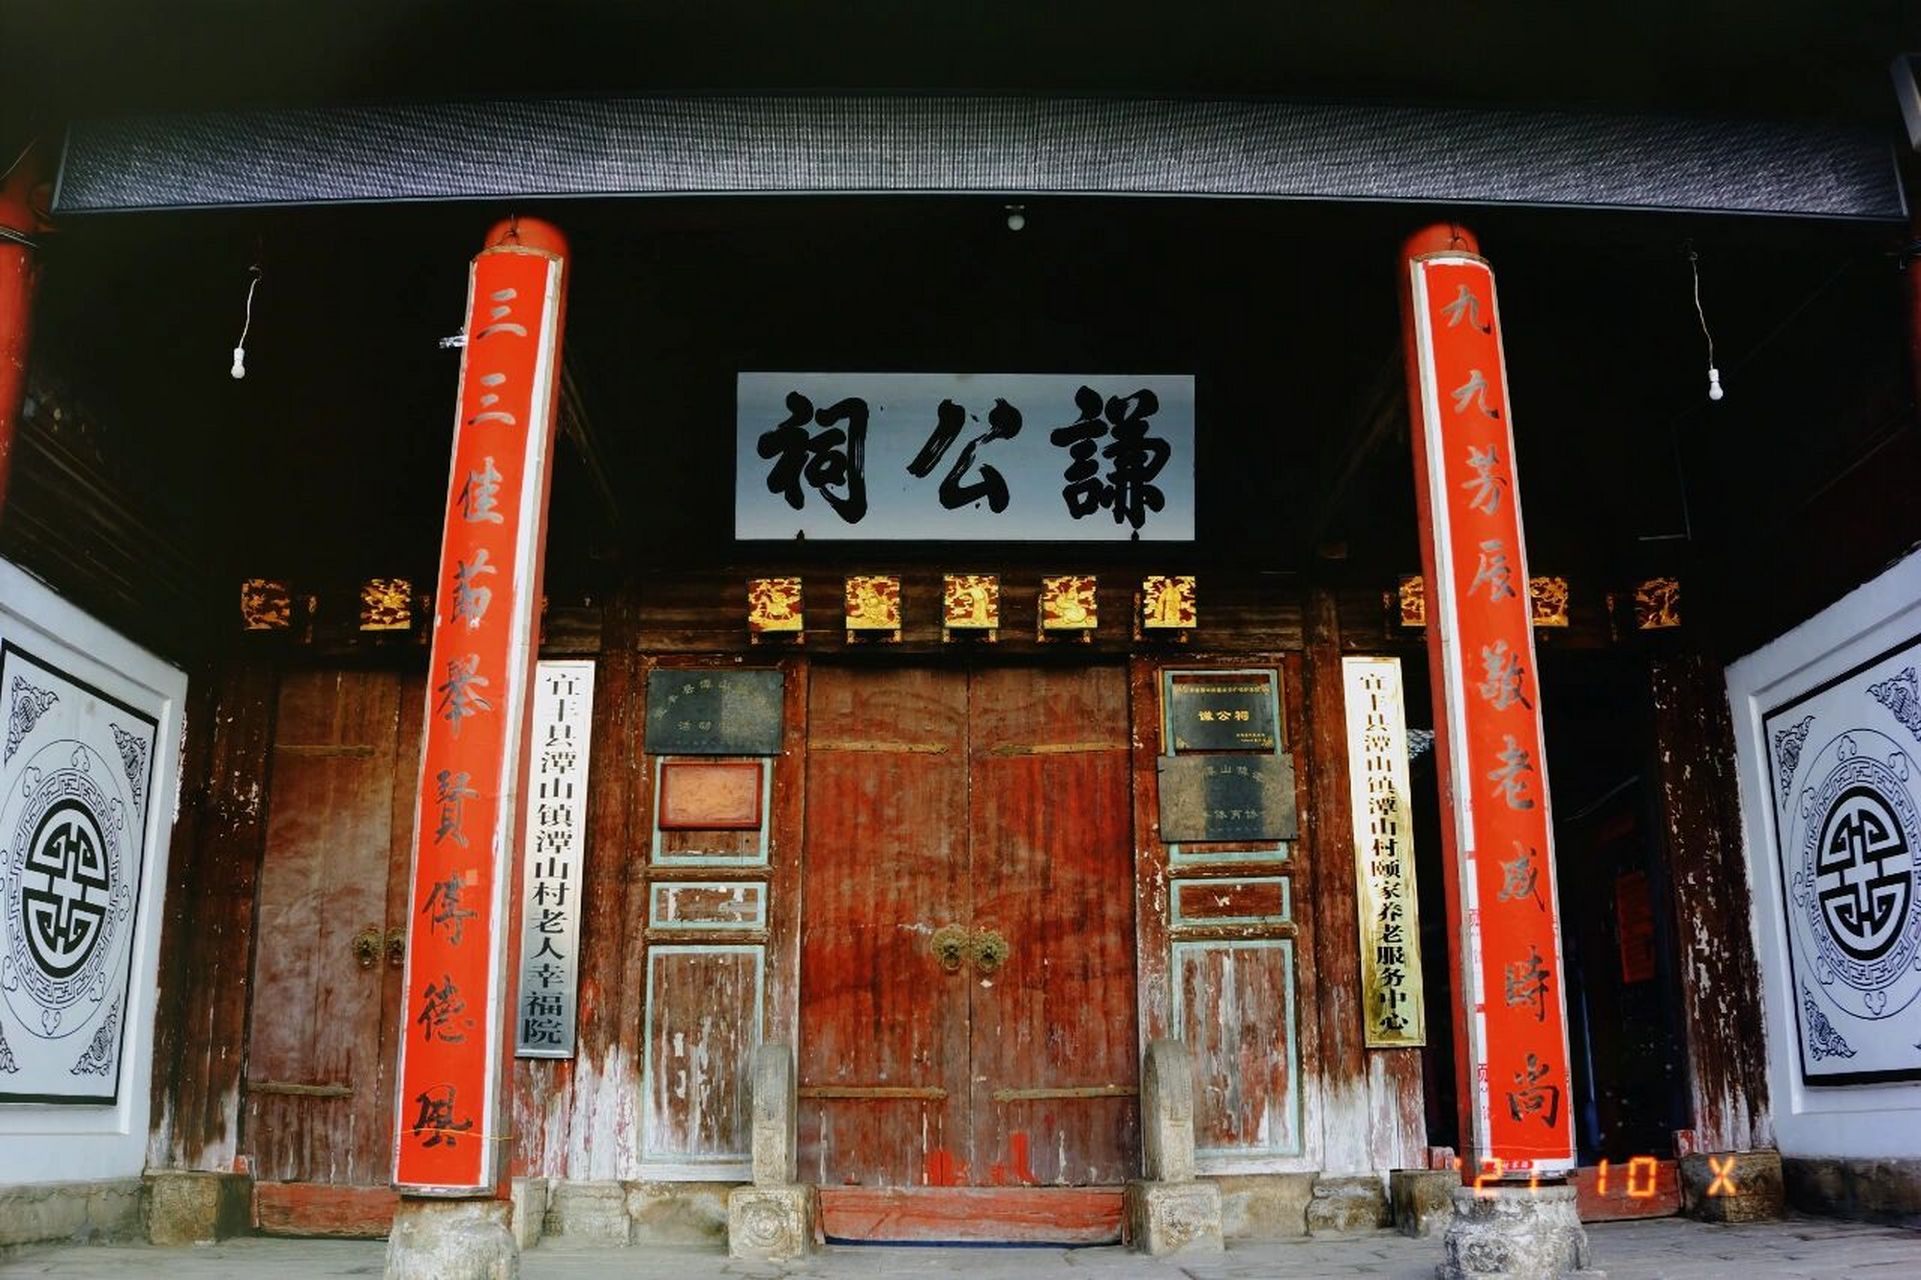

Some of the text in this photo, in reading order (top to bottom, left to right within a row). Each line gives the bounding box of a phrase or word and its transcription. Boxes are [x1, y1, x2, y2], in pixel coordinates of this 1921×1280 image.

[523, 674, 580, 1044] 宜丰县潭山镇潭山村老人幸福院
